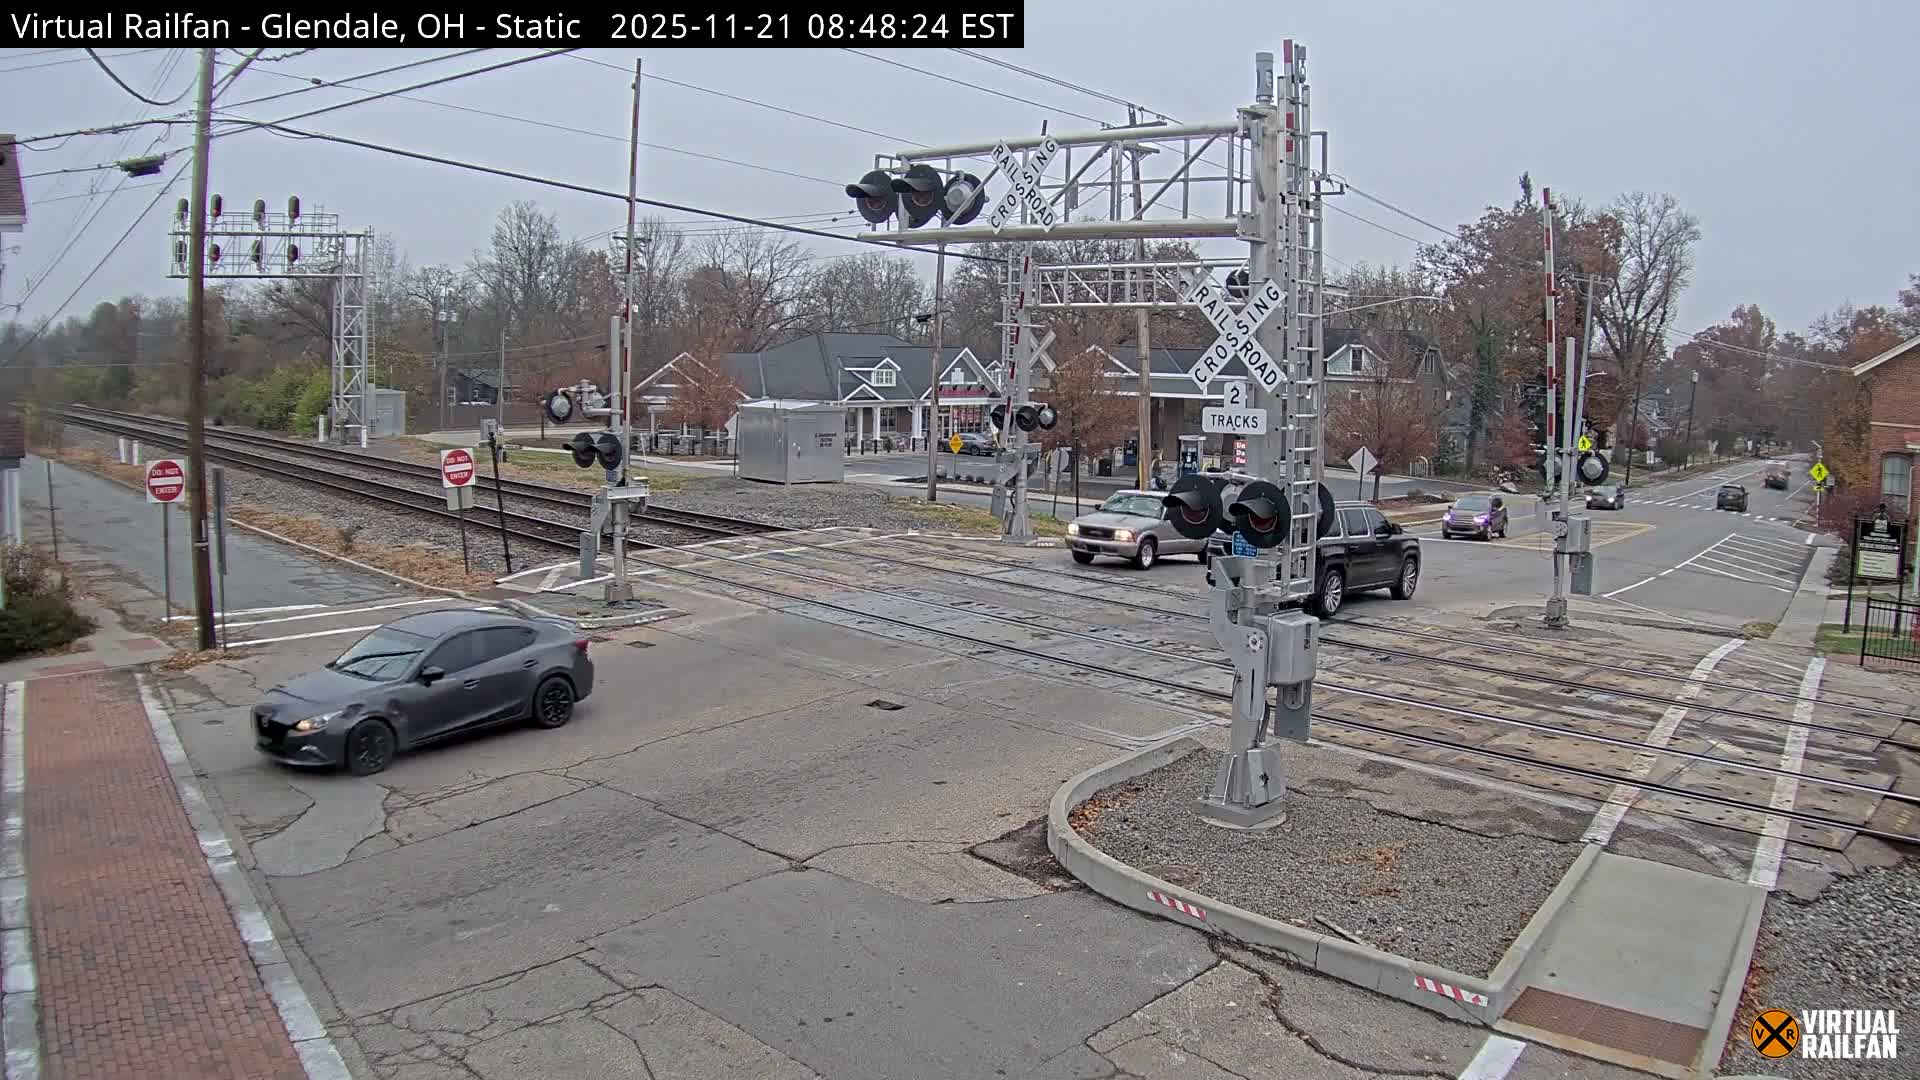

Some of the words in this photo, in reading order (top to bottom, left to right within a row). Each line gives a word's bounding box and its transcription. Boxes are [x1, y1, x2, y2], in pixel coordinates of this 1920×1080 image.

[990, 139, 1055, 228] CROSSING
[1194, 284, 1280, 383] CROSSING
[1211, 414, 1258, 428] TRACKS
[1230, 387, 1240, 404] 2
